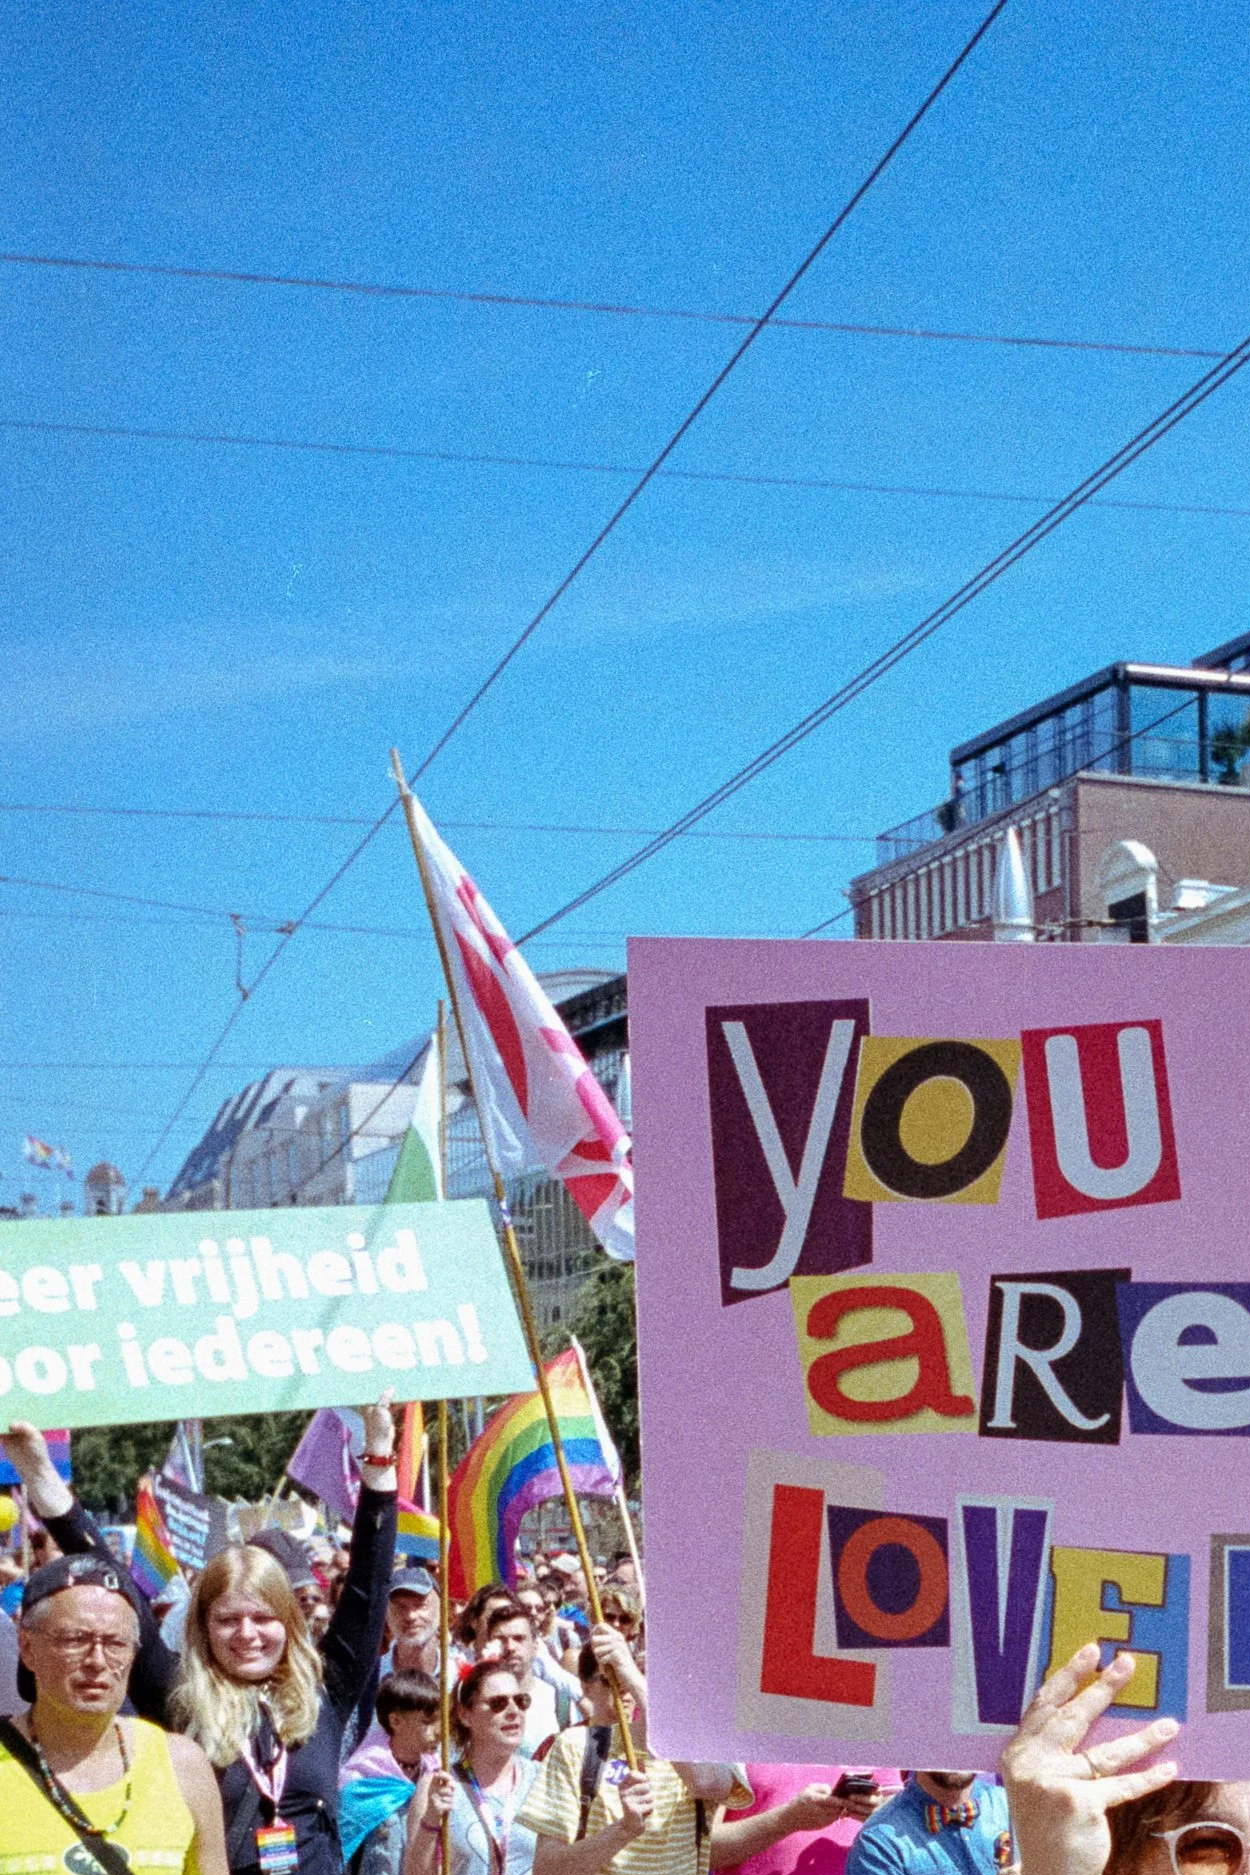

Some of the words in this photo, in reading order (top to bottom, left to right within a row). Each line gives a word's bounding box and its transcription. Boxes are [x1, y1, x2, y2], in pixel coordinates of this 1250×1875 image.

[119, 1229, 428, 1319] vrijheid
[0, 1343, 100, 1395] or
[117, 1304, 488, 1388] iedereen!
